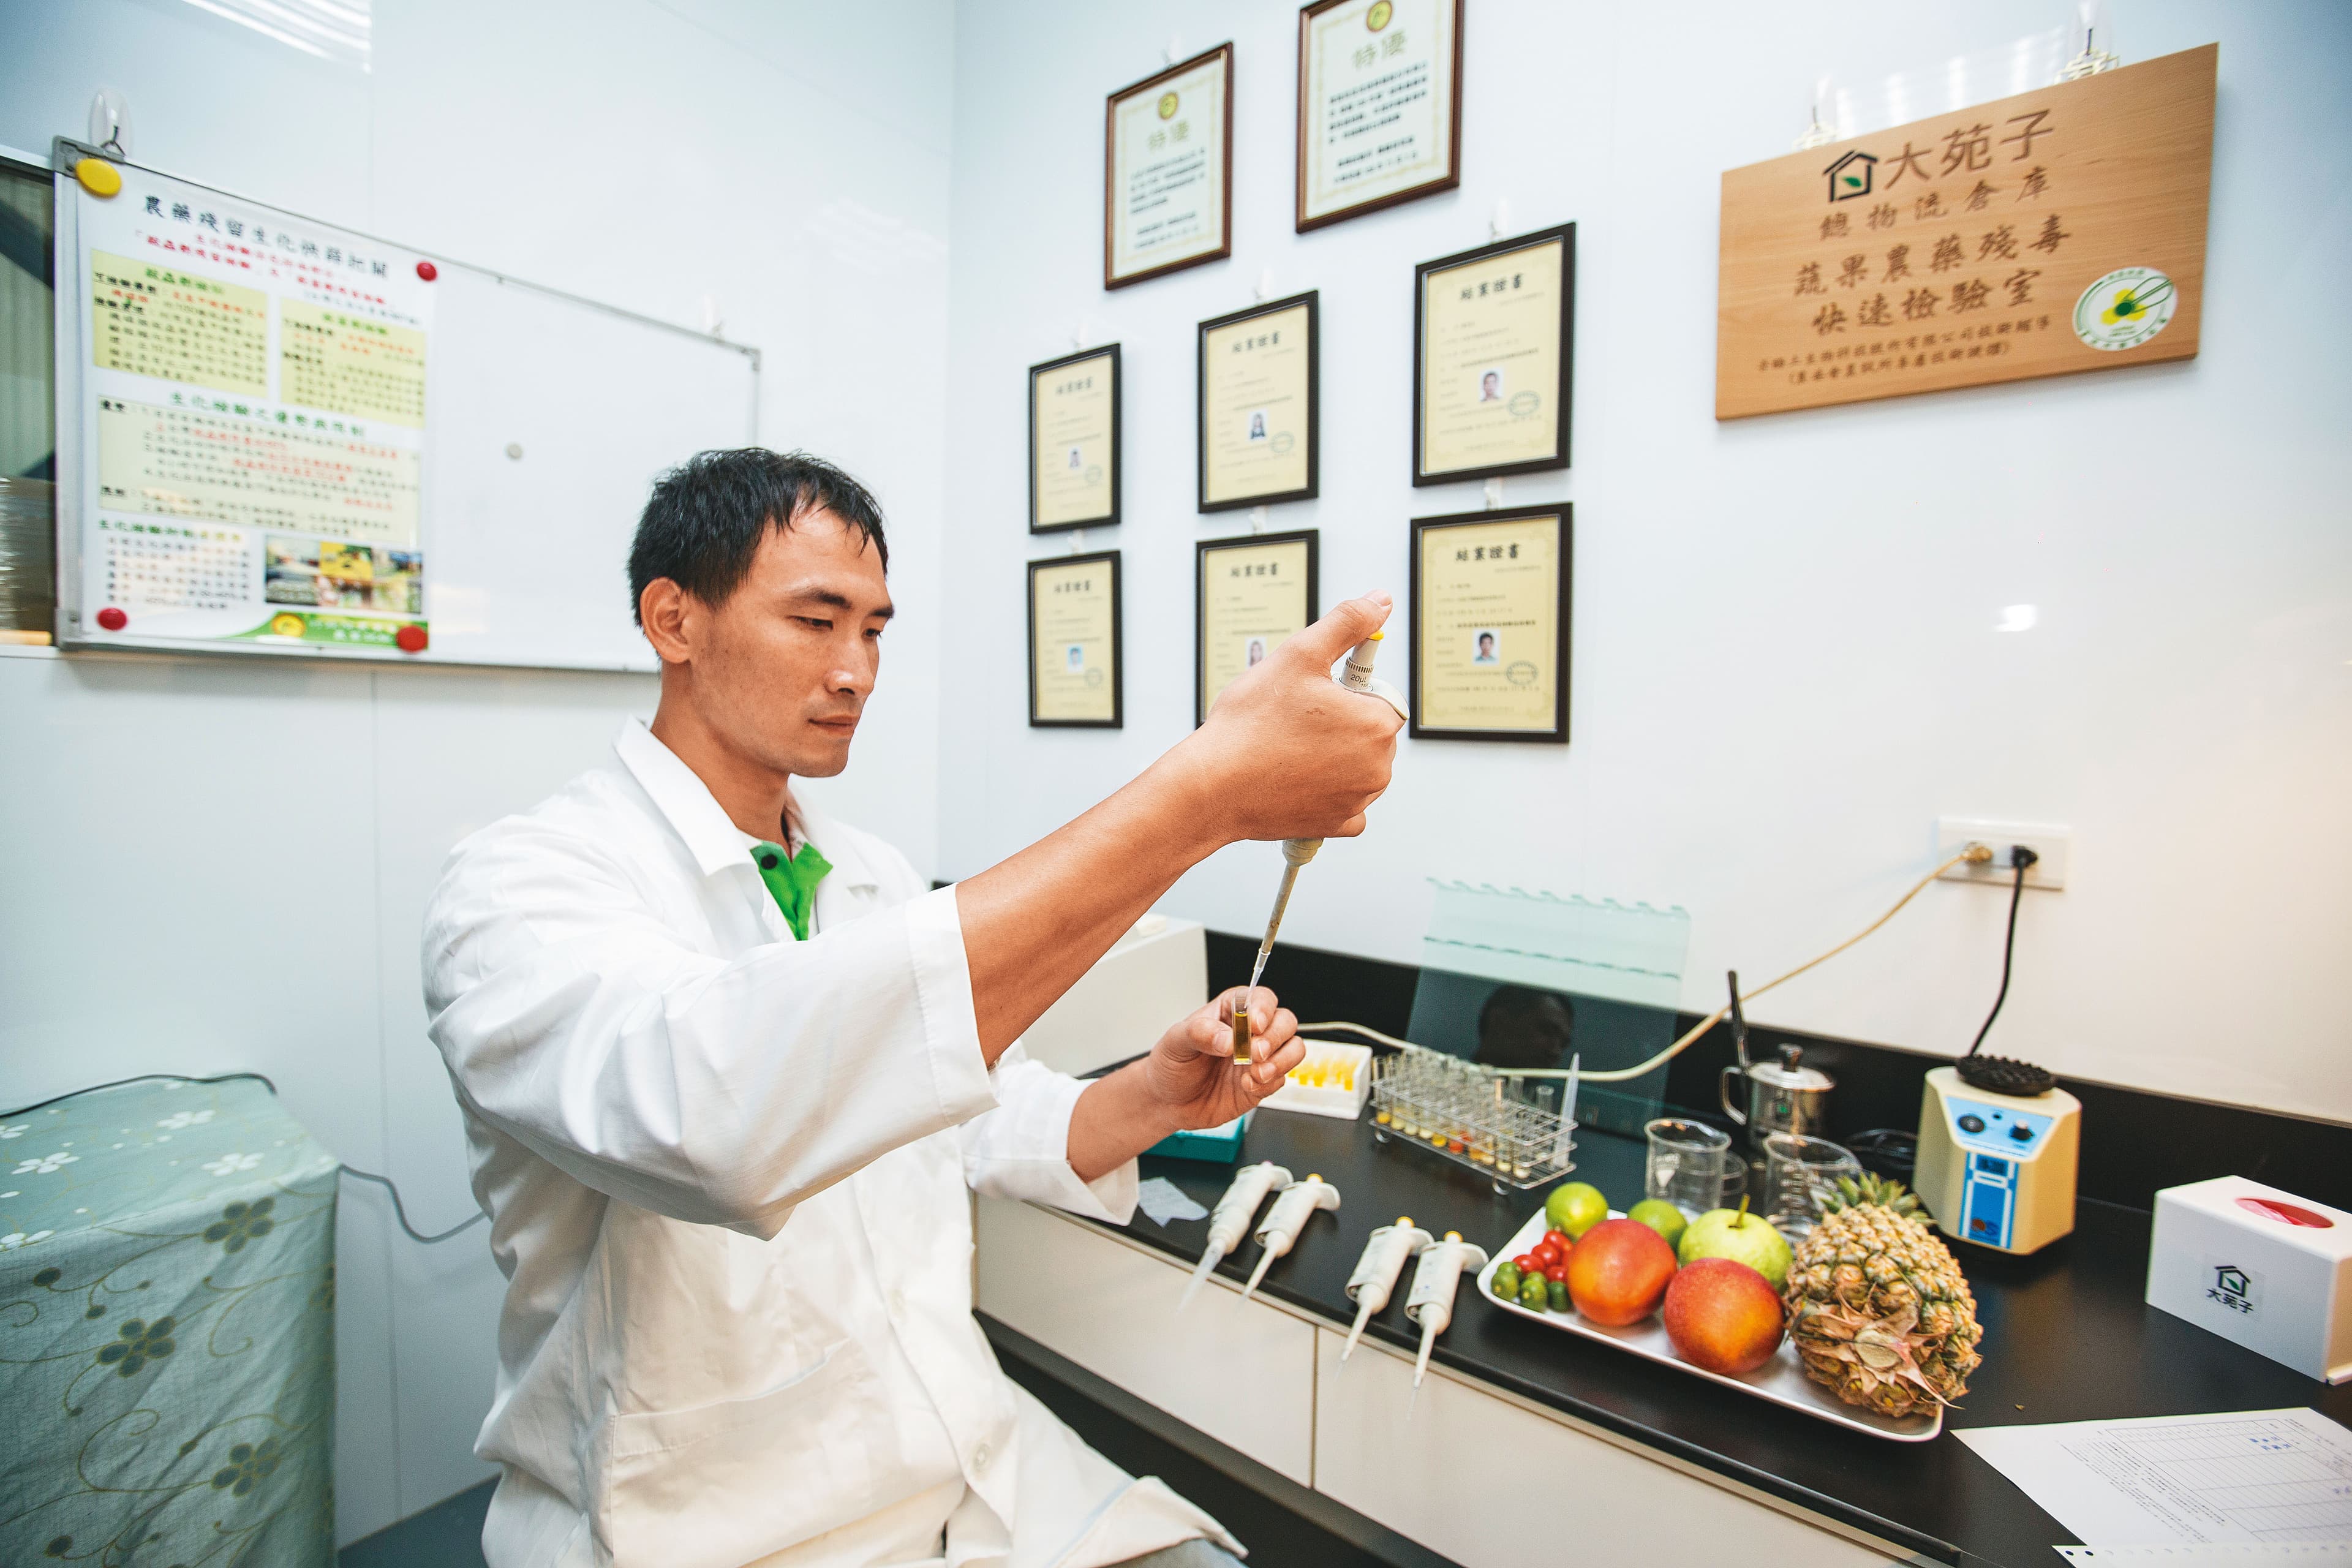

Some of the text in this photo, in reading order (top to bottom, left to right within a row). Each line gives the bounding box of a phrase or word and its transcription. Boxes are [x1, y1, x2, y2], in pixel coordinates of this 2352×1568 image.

[1885, 108, 2056, 189] 大苑子
[1819, 166, 2051, 240] 總物流倉庫
[1795, 214, 2071, 297] 蔬果農藥殘毒
[1812, 268, 2042, 336] 快速檢驗室
[2206, 1287, 2255, 1314] 大苑子
